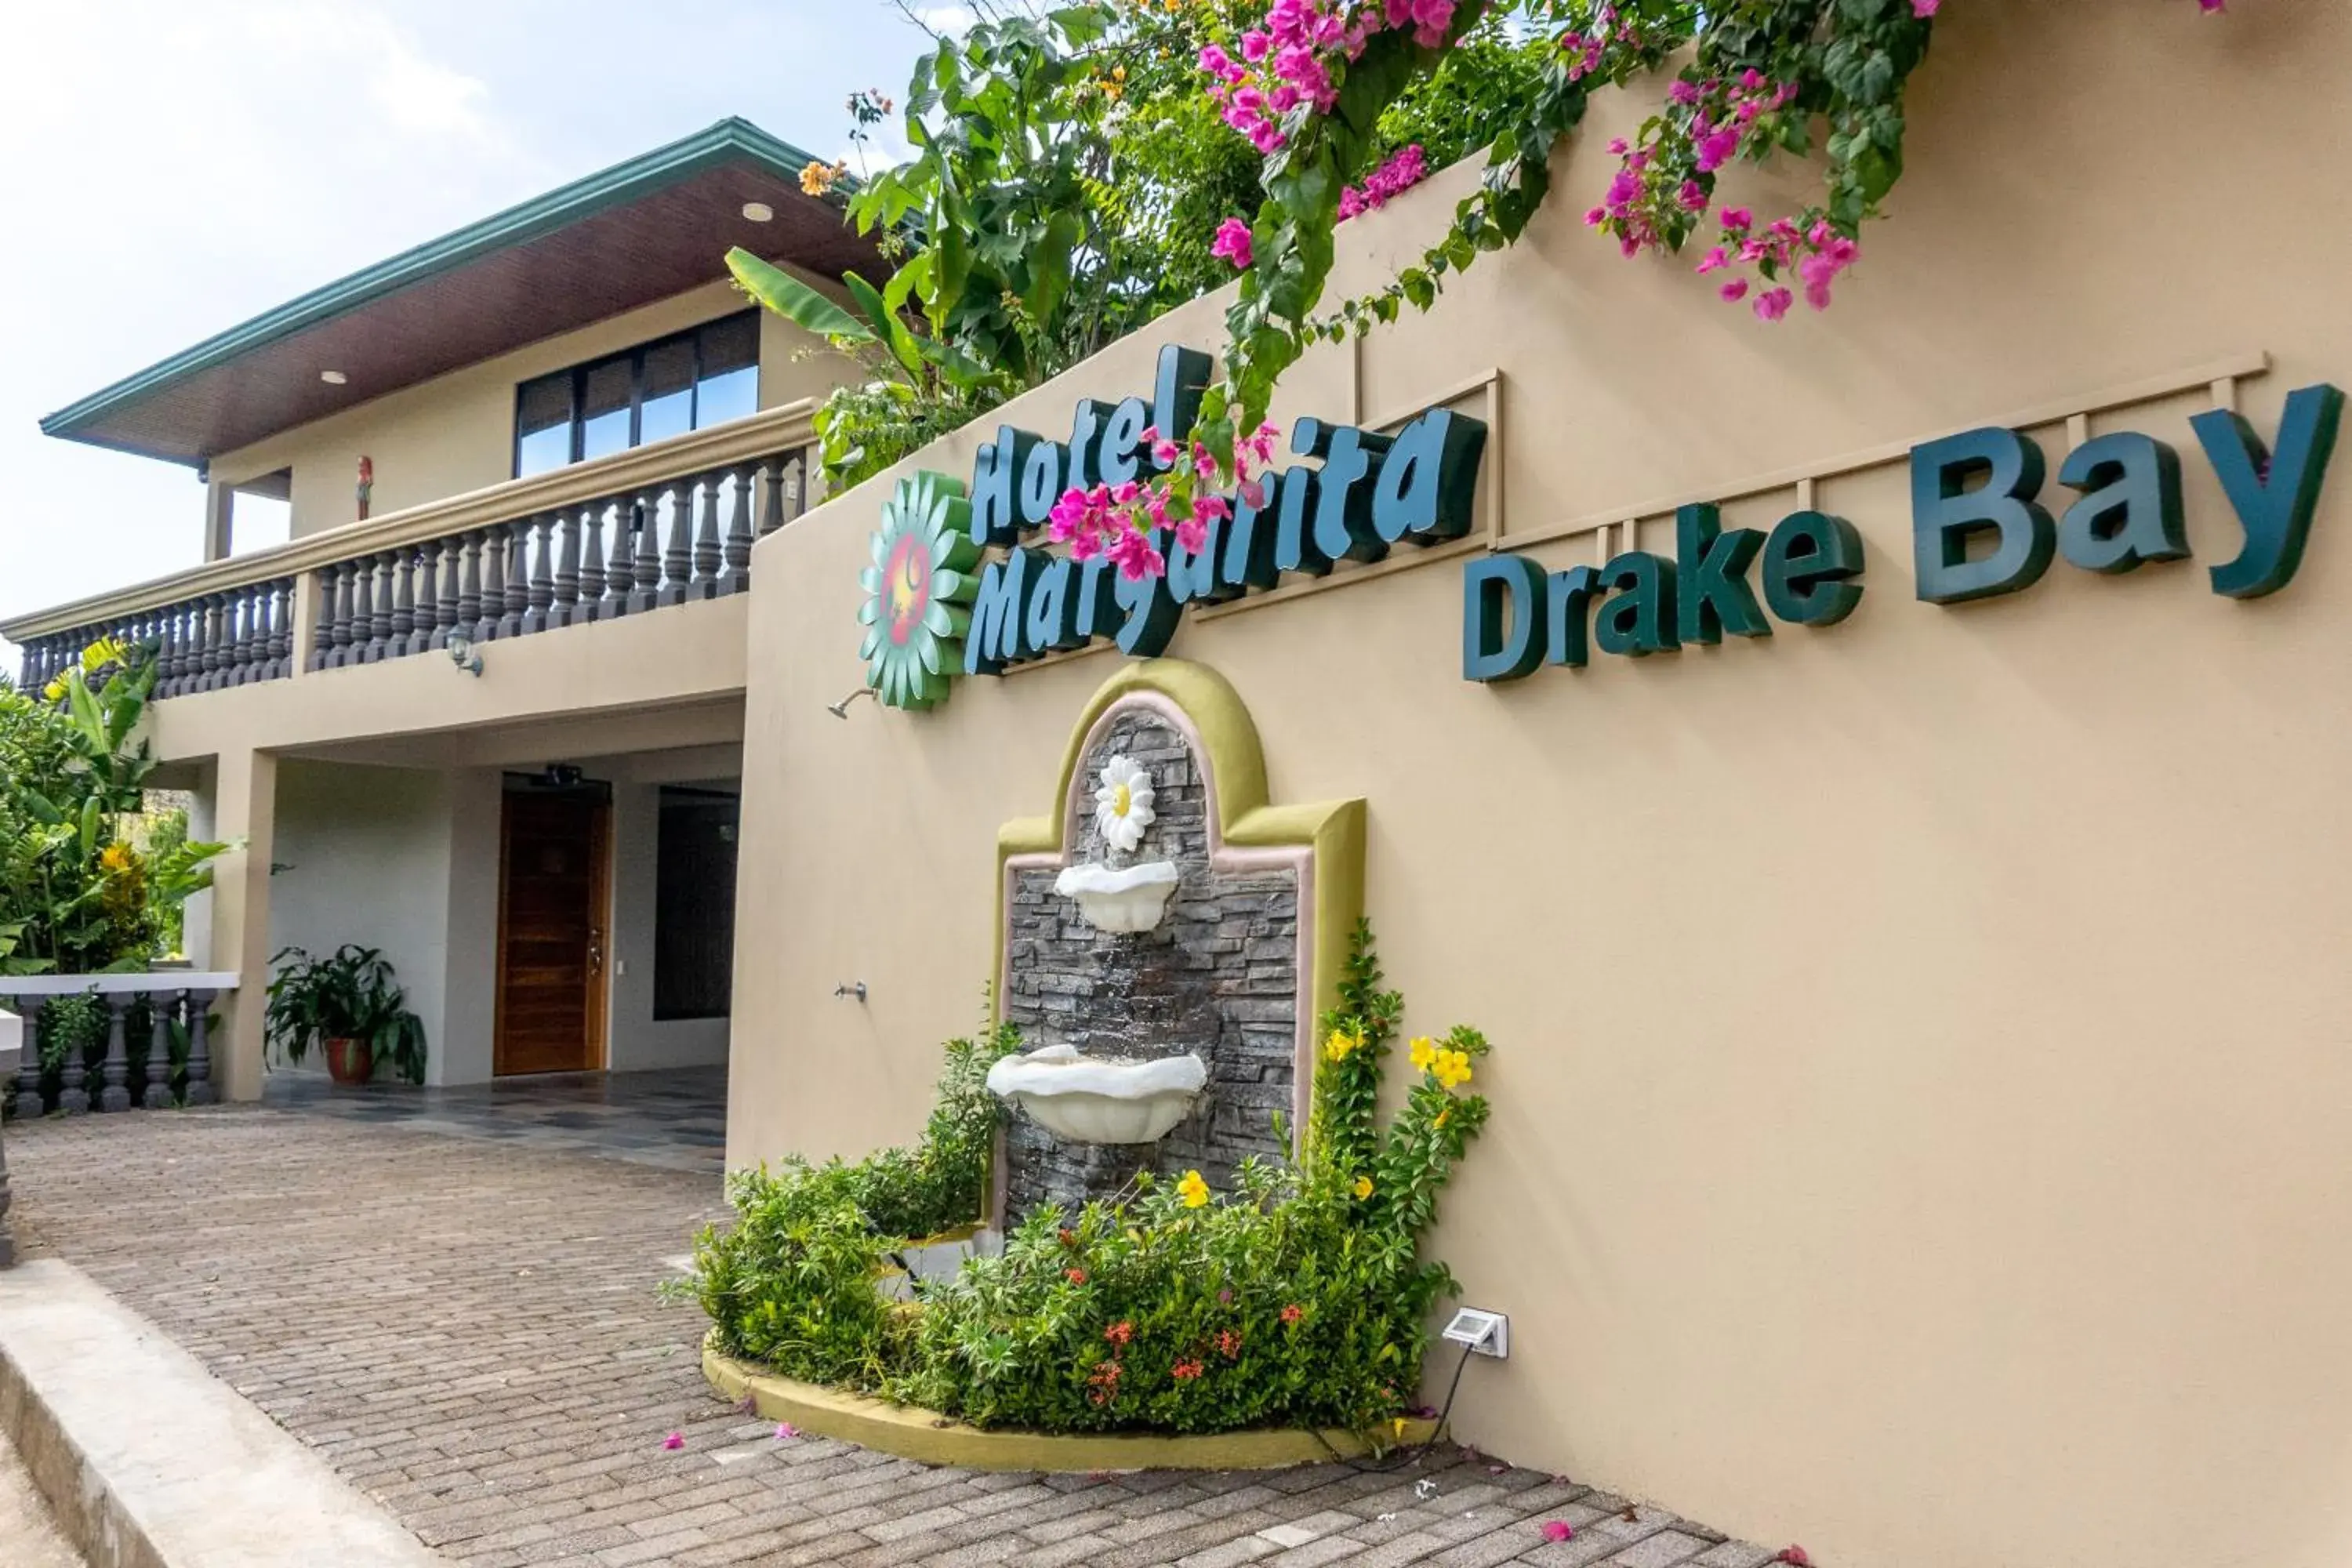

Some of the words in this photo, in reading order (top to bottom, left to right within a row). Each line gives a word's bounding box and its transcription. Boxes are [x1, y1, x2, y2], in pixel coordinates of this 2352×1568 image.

[971, 345, 1203, 544] Hotel
[1463, 503, 1864, 682] Drake
[1911, 383, 2343, 603] Bay
